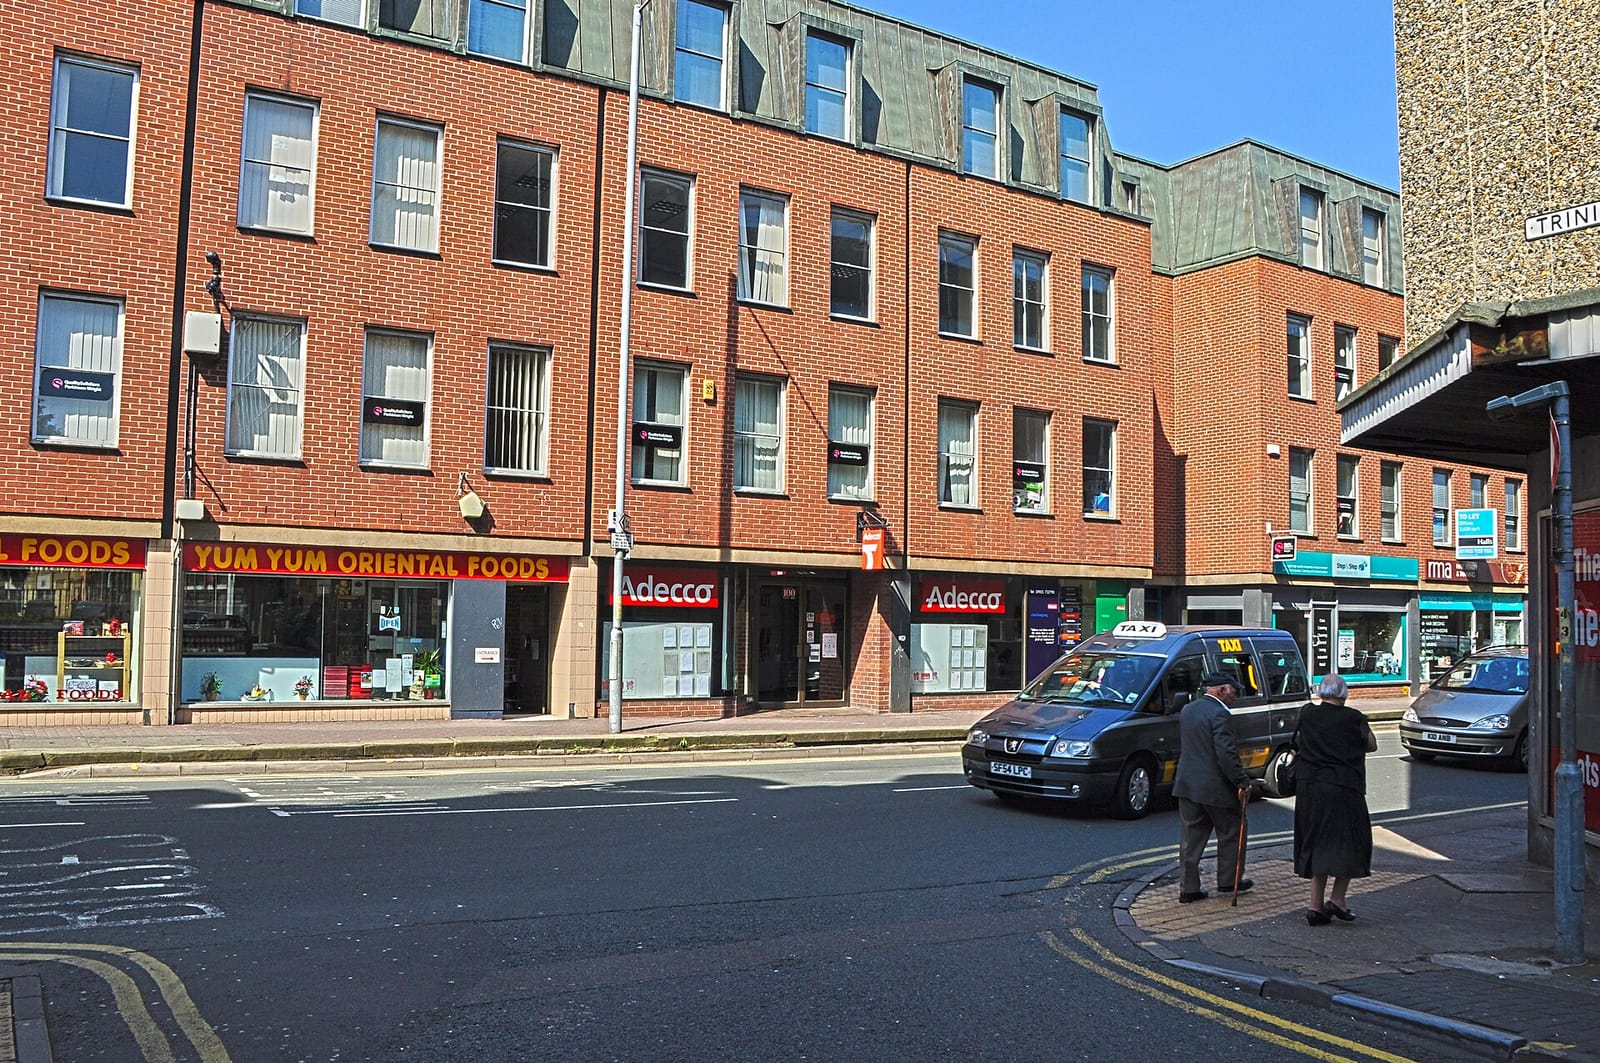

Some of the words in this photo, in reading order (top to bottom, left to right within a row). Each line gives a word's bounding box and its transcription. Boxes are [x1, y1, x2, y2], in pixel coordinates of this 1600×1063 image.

[21, 538, 130, 565] FOODS
[194, 545, 258, 570] YUM
[266, 548, 327, 573] YUM
[337, 551, 459, 577] ORIENTAL
[467, 555, 549, 579] FOODS
[621, 574, 714, 604] Adecco
[926, 584, 1002, 610] Adecco
[380, 617, 400, 629] OPEN
[1120, 624, 1157, 633] TAXI
[1217, 638, 1243, 653] TAXI
[56, 689, 124, 702] FOODS
